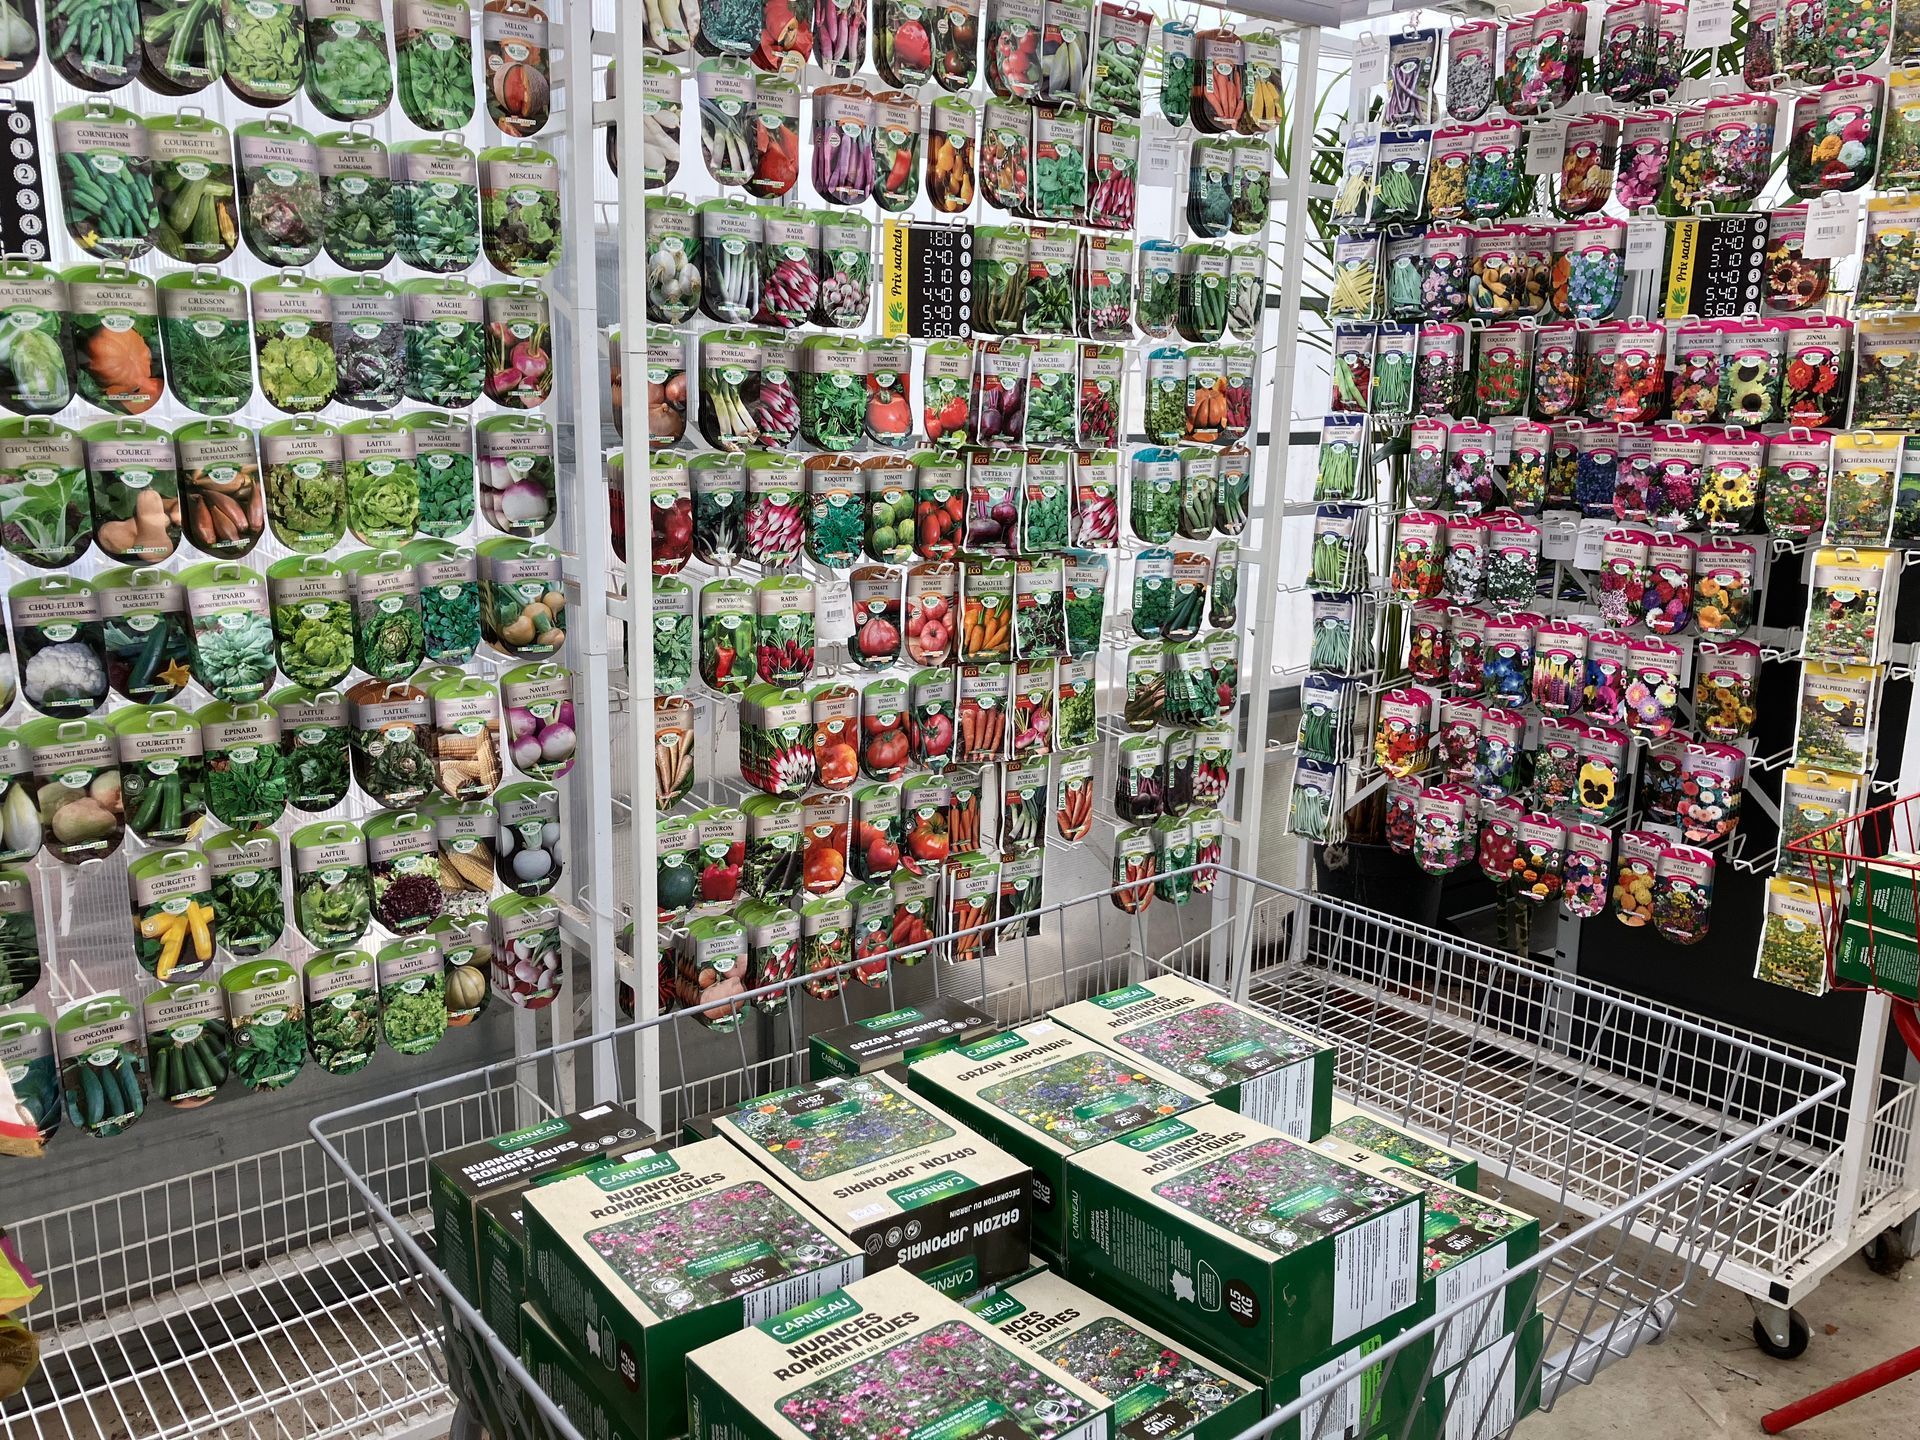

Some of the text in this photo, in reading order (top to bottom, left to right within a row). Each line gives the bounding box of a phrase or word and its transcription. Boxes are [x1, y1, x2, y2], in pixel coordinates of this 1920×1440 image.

[504, 22, 528, 31] MELON
[716, 80, 741, 88] POIREAU
[756, 94, 784, 103] POTIRON
[1708, 112, 1722, 120] POIS
[15, 118, 23, 128] 0
[76, 129, 129, 140] CORNICHON
[20, 143, 25, 154] 1
[163, 138, 216, 148] COURGETTE
[338, 155, 366, 163] LAITUE
[21, 168, 29, 179] 2
[509, 172, 542, 180] MESCLUN
[24, 194, 32, 204] 3
[26, 219, 34, 229] 4
[1720, 219, 1746, 233] 1.80
[930, 231, 968, 246] 1.80 0
[1712, 236, 1744, 251] 2.40
[30, 244, 37, 254] 5
[923, 249, 953, 265] 2.40
[963, 273, 967, 281] 2
[1677, 262, 1688, 282] Prix
[1708, 270, 1740, 284] 4.40
[891, 272, 902, 296] Prix
[96, 291, 133, 299] COURGE
[923, 287, 967, 302] 4.40 3
[1706, 286, 1754, 300] 5.40 4
[187, 297, 225, 305] CRESSON
[351, 302, 379, 310] LAITUE
[923, 305, 967, 320] 5.40 4
[1704, 303, 1735, 316] 5.60
[922, 322, 967, 338] 5.60 5
[1746, 336, 1781, 344] TOURNESOL
[721, 350, 746, 358] POIREAU
[5, 444, 70, 454] CHOU CHINOIS
[200, 445, 239, 454] ECHALION
[291, 441, 318, 449] LAITUE
[366, 440, 392, 448] LAITUE
[116, 448, 151, 456] COURGE
[1501, 536, 1530, 544] GYPSOPHILE
[922, 580, 942, 588] TOMATE
[114, 592, 165, 601] COURGETTE
[212, 591, 246, 600] ÉPINARD
[28, 601, 84, 611] CHOU-FLEUR
[1647, 657, 1678, 665] MARGUERITE
[529, 686, 549, 694] NAVET
[973, 681, 997, 689] CAROTTE
[1806, 682, 1828, 691] SPÉCIAL
[383, 707, 410, 715] LAITUE
[826, 703, 846, 711] TOMATE
[224, 726, 258, 736] ÉPINARD
[136, 738, 186, 747] COURGETTE
[32, 746, 111, 762] CHOU NAVET RUTABAGA
[1791, 790, 1842, 805] SPÉCIAL ABEILLES
[813, 808, 835, 816] TOMATE
[704, 825, 732, 833] POIVRON
[392, 837, 418, 846] LAITUE
[660, 834, 687, 844] PASTÈQUE
[227, 852, 260, 861] ÉPINARD
[320, 850, 346, 858] LAITUE
[151, 875, 196, 890] COURGETTE
[965, 880, 988, 889] CAROTTE
[1855, 880, 1866, 908] CARNEAU
[1780, 903, 1816, 916] TERRAIN SEC
[1842, 937, 1853, 964] CARNEAU
[330, 974, 354, 985] LAITUE
[254, 989, 286, 1002] ÉPINARD
[1098, 987, 1147, 1007] CARNEAU
[158, 999, 210, 1016] COURGETTE
[1106, 996, 1196, 1029] ROMANTIQUES
[1112, 995, 1171, 1018] NUANCES
[866, 1010, 918, 1029] CARNEAU
[73, 1023, 125, 1042] CONCOMBRE
[849, 1018, 949, 1051] GAZON JAPONAIS
[965, 1034, 1021, 1059] CARNEAU
[821, 1052, 846, 1072] CARNEAU
[957, 1038, 1074, 1082] GAZON JAPONAIS
[498, 1121, 565, 1149] CARNEAU
[1129, 1122, 1186, 1148] CARNEAU
[1142, 1131, 1248, 1176] ROMANTIQUES
[1146, 1132, 1217, 1162] NUANCES
[461, 1147, 535, 1175] NUANCES
[468, 1140, 580, 1182] ROMANTIQUES
[598, 1158, 672, 1186] CARNEAU
[832, 1147, 977, 1199] GAZON JAPONAIS
[605, 1171, 696, 1204] NUANCES
[898, 1176, 965, 1204] CARNEAU
[1032, 1178, 1041, 1199] 0.5
[1040, 1184, 1050, 1204] KG
[589, 1172, 726, 1219] ROMANTIQUES
[949, 1188, 1021, 1218] DÉCORATION DU JARDIN
[898, 1208, 1020, 1264] GAZON JAPONAIS
[1230, 1288, 1242, 1313] 0.5
[1241, 1296, 1253, 1318] KG
[772, 1297, 852, 1337] CARNEAU
[998, 1310, 1046, 1336] NCES
[786, 1311, 884, 1360] NUANCES
[1036, 1326, 1072, 1351] DU JARDIN
[772, 1311, 920, 1382] ROMANTIQUES
[814, 1330, 910, 1376] DÉCORATION DU JARDIN
